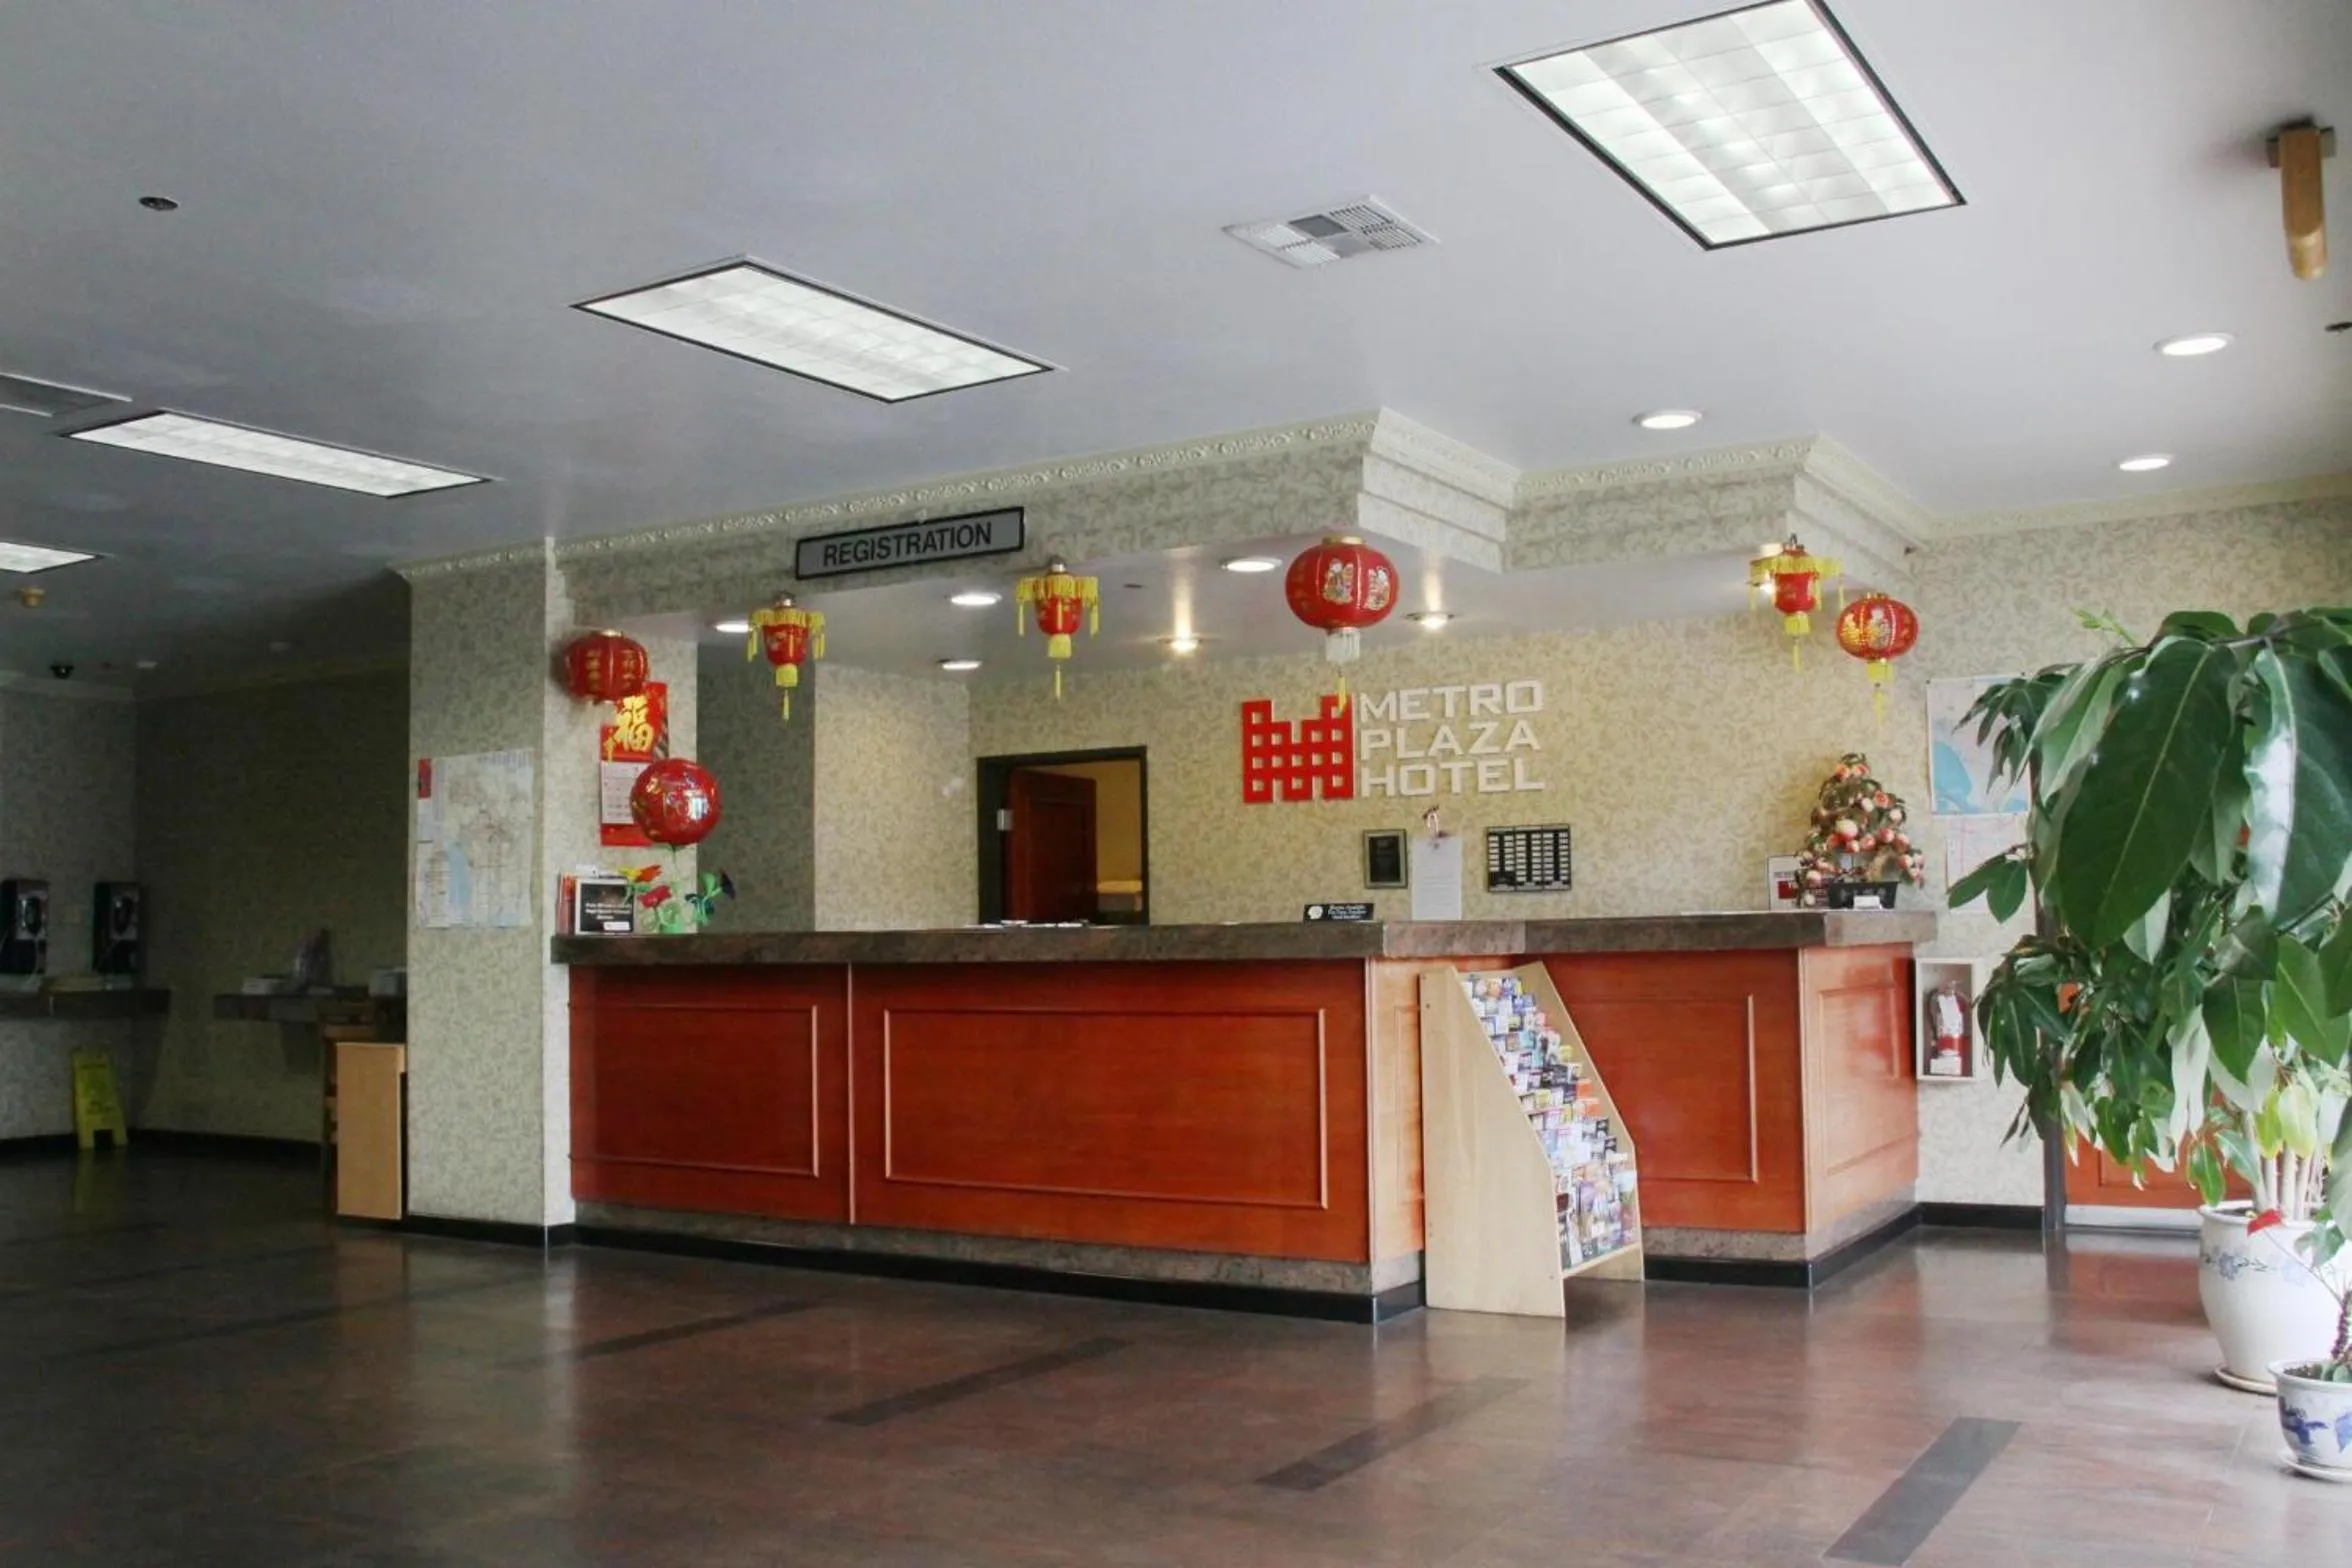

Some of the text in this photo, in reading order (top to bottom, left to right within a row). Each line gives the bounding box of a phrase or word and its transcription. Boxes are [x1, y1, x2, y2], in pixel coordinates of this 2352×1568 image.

[823, 522, 992, 567] REGISTRATION
[1360, 680, 1544, 722] METRO
[613, 695, 654, 752] 福
[1361, 720, 1542, 760] PLAZA
[1361, 758, 1546, 797] HOTEL
